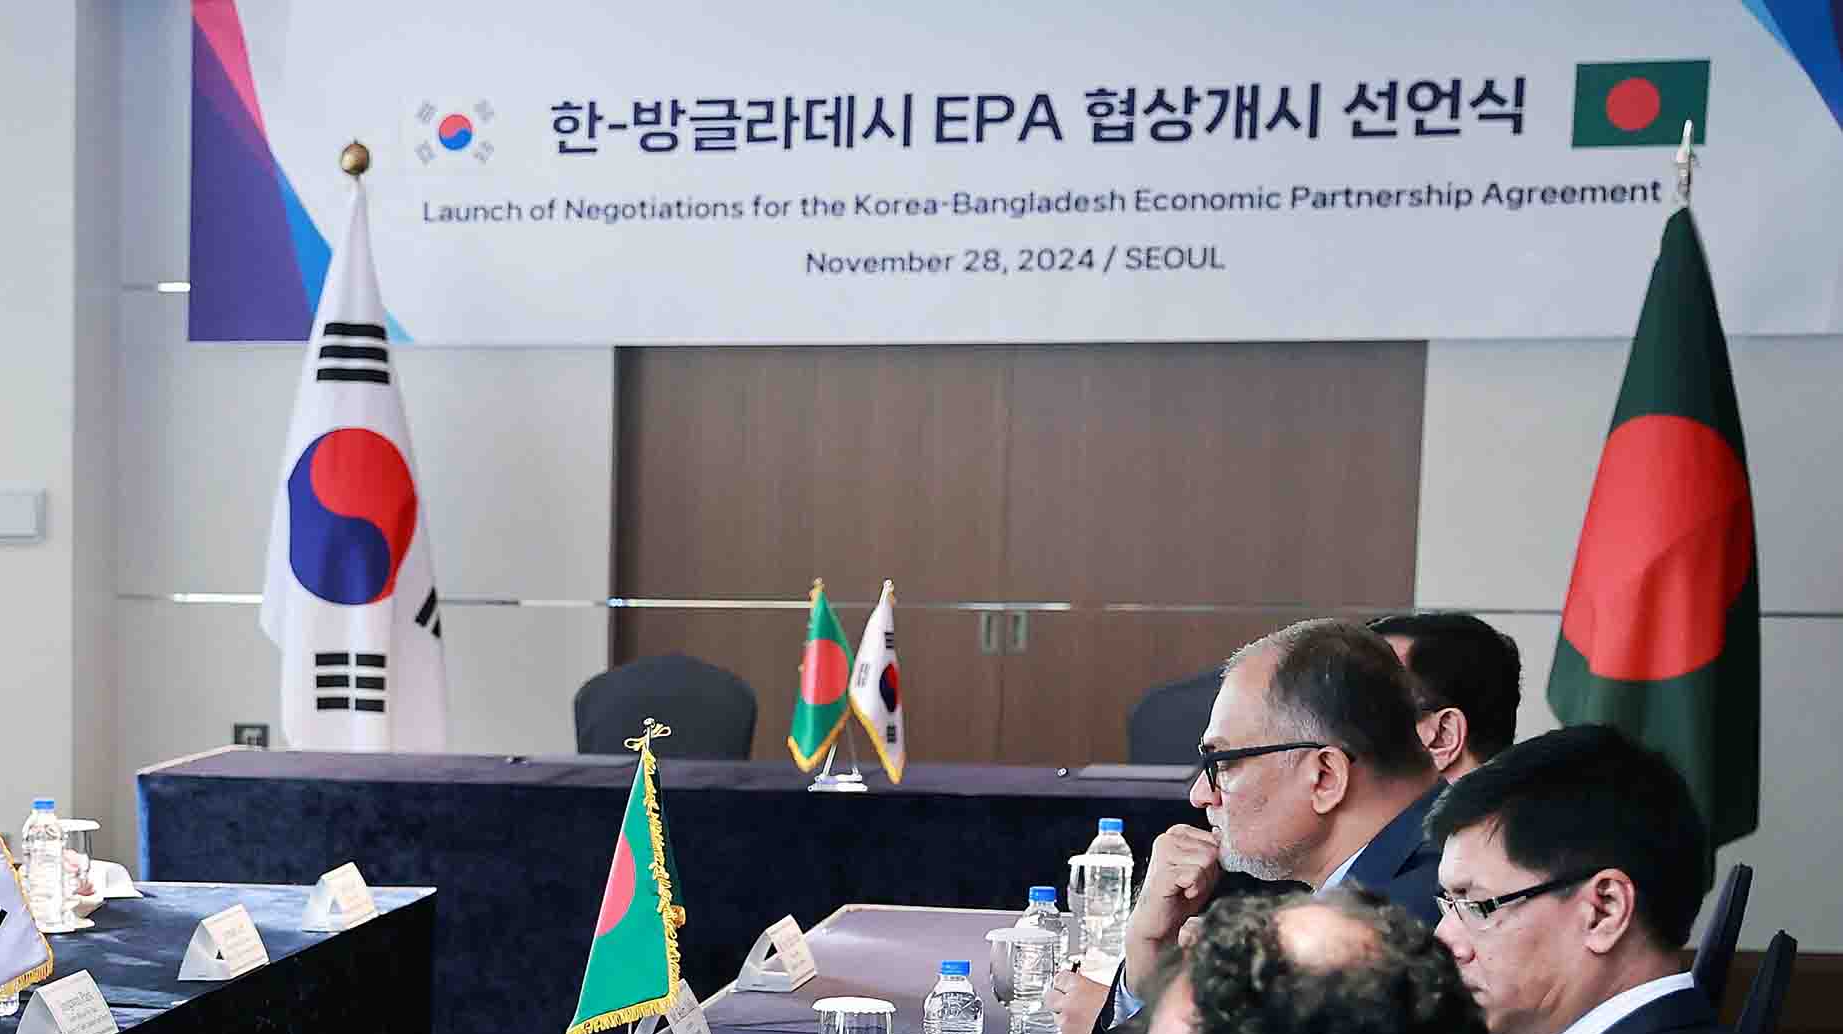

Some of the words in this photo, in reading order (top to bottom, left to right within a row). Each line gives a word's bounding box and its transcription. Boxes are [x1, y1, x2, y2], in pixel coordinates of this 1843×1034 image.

[550, 91, 914, 156] 한-방글라데시
[934, 92, 1065, 145] EPA
[1083, 82, 1322, 145] 협상개시
[1341, 75, 1527, 140] 선언식
[423, 200, 523, 223] Launch
[529, 198, 556, 221] of
[565, 196, 744, 225] Negotiations
[753, 195, 792, 218] for
[799, 194, 847, 218] the
[853, 188, 1126, 219] Korea-Bangladesh
[1134, 186, 1282, 213] Economic
[1290, 181, 1474, 211] Partnership
[1481, 179, 1662, 210] Agreement
[806, 250, 953, 275] November
[963, 249, 1008, 276] 28,
[1017, 247, 1095, 273] 2024
[1103, 245, 1118, 274] /
[1125, 245, 1226, 271] SEOUL
